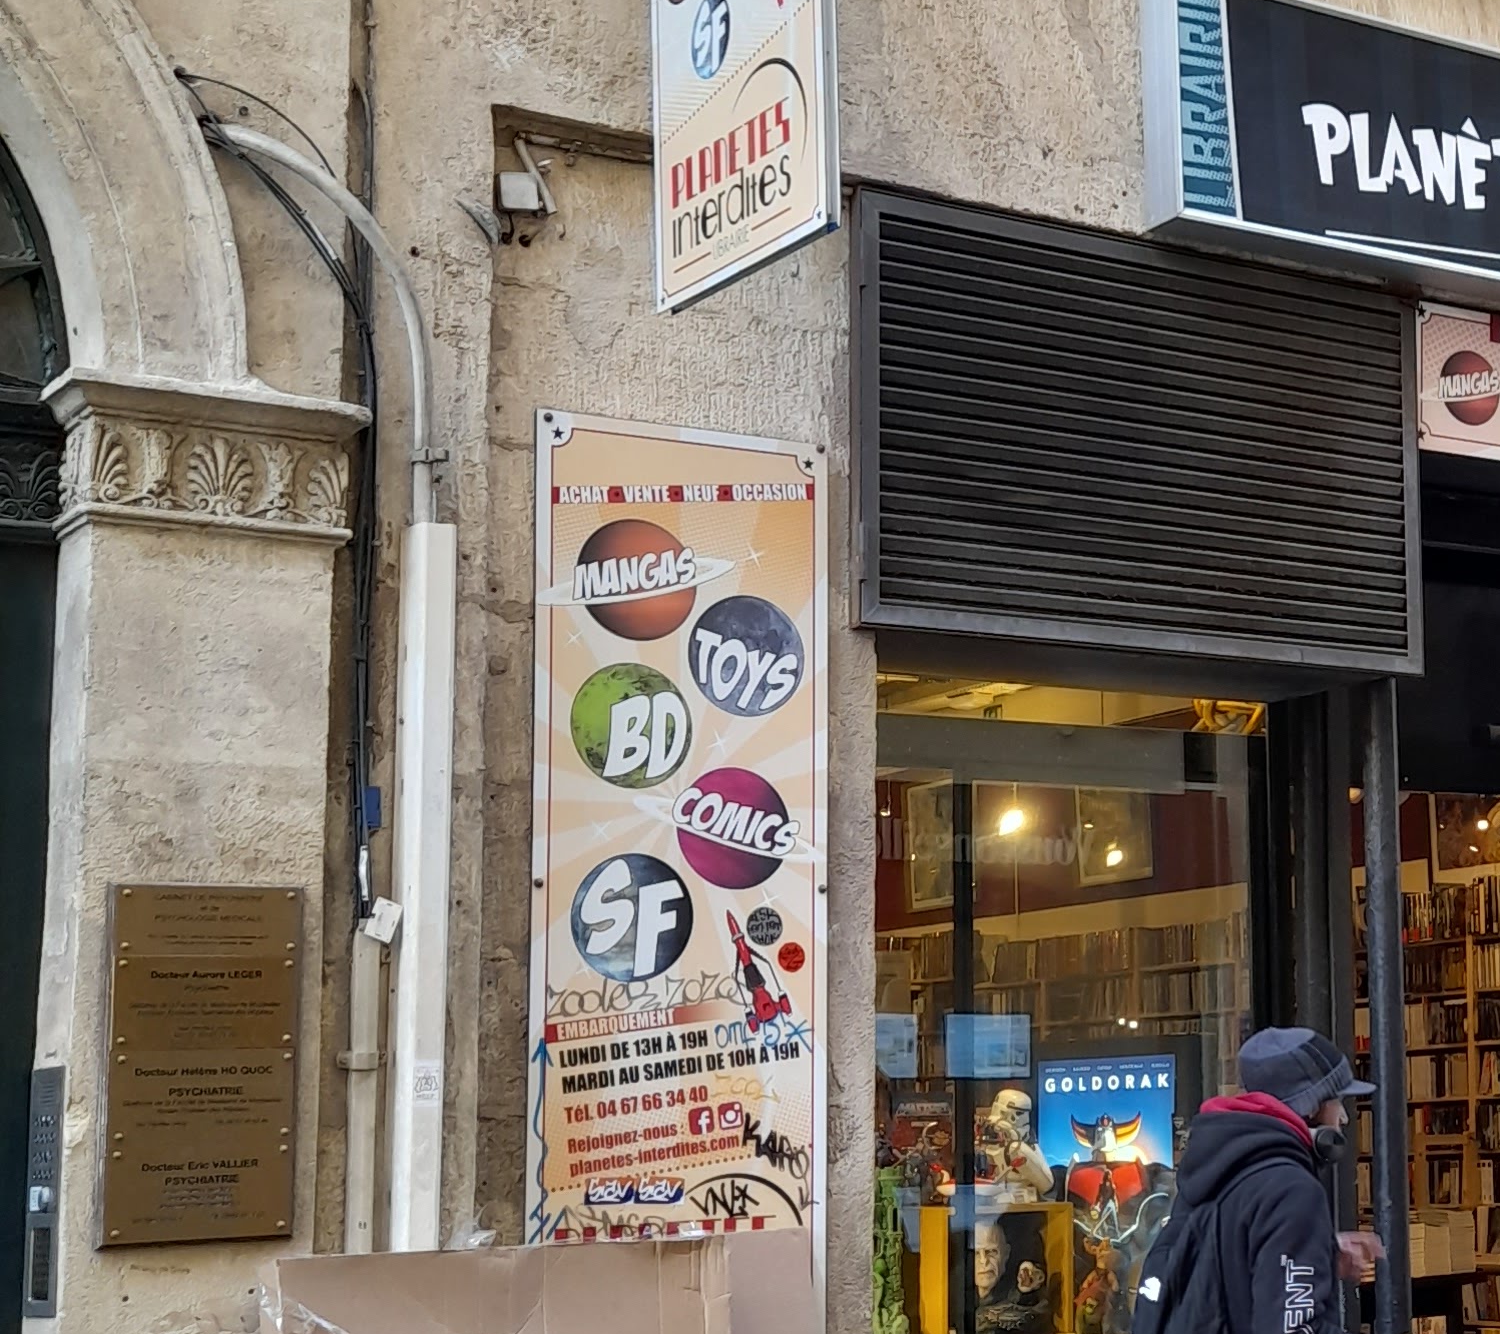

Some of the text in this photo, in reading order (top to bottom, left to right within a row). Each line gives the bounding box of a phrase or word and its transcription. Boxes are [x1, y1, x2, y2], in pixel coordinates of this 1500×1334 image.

[694, 0, 727, 73] SF
[671, 96, 790, 210] PLANETES
[712, 224, 750, 260] LIBRAIRIE
[1438, 370, 1499, 399] MANGAS
[559, 483, 807, 504] ACHAT VENTE NEUF OCCASION
[573, 547, 697, 601] MANGAS
[695, 628, 798, 710] TOYS
[602, 691, 687, 779] BD
[672, 786, 800, 856] COMICS
[580, 858, 684, 977] SF
[151, 970, 189, 979] Docteur
[557, 1008, 675, 1042] EMBARQUEMENT
[559, 1030, 708, 1069] LUNDI DE 13H À 19H
[561, 1042, 801, 1095] MARDI AU SAMEDI DE 10H À 19H
[135, 1067, 178, 1078] Docteur
[220, 1066, 237, 1076] HO
[1045, 1073, 1169, 1094] GOLDORAK
[168, 1086, 244, 1097] PSYCHIATRIE
[564, 1086, 708, 1124] Tél. 04 67 66 34 40
[141, 1162, 184, 1173] Docteur
[569, 1134, 740, 1178] planetes-interdites.com
[164, 1174, 240, 1186] PSYCHIATRIE
